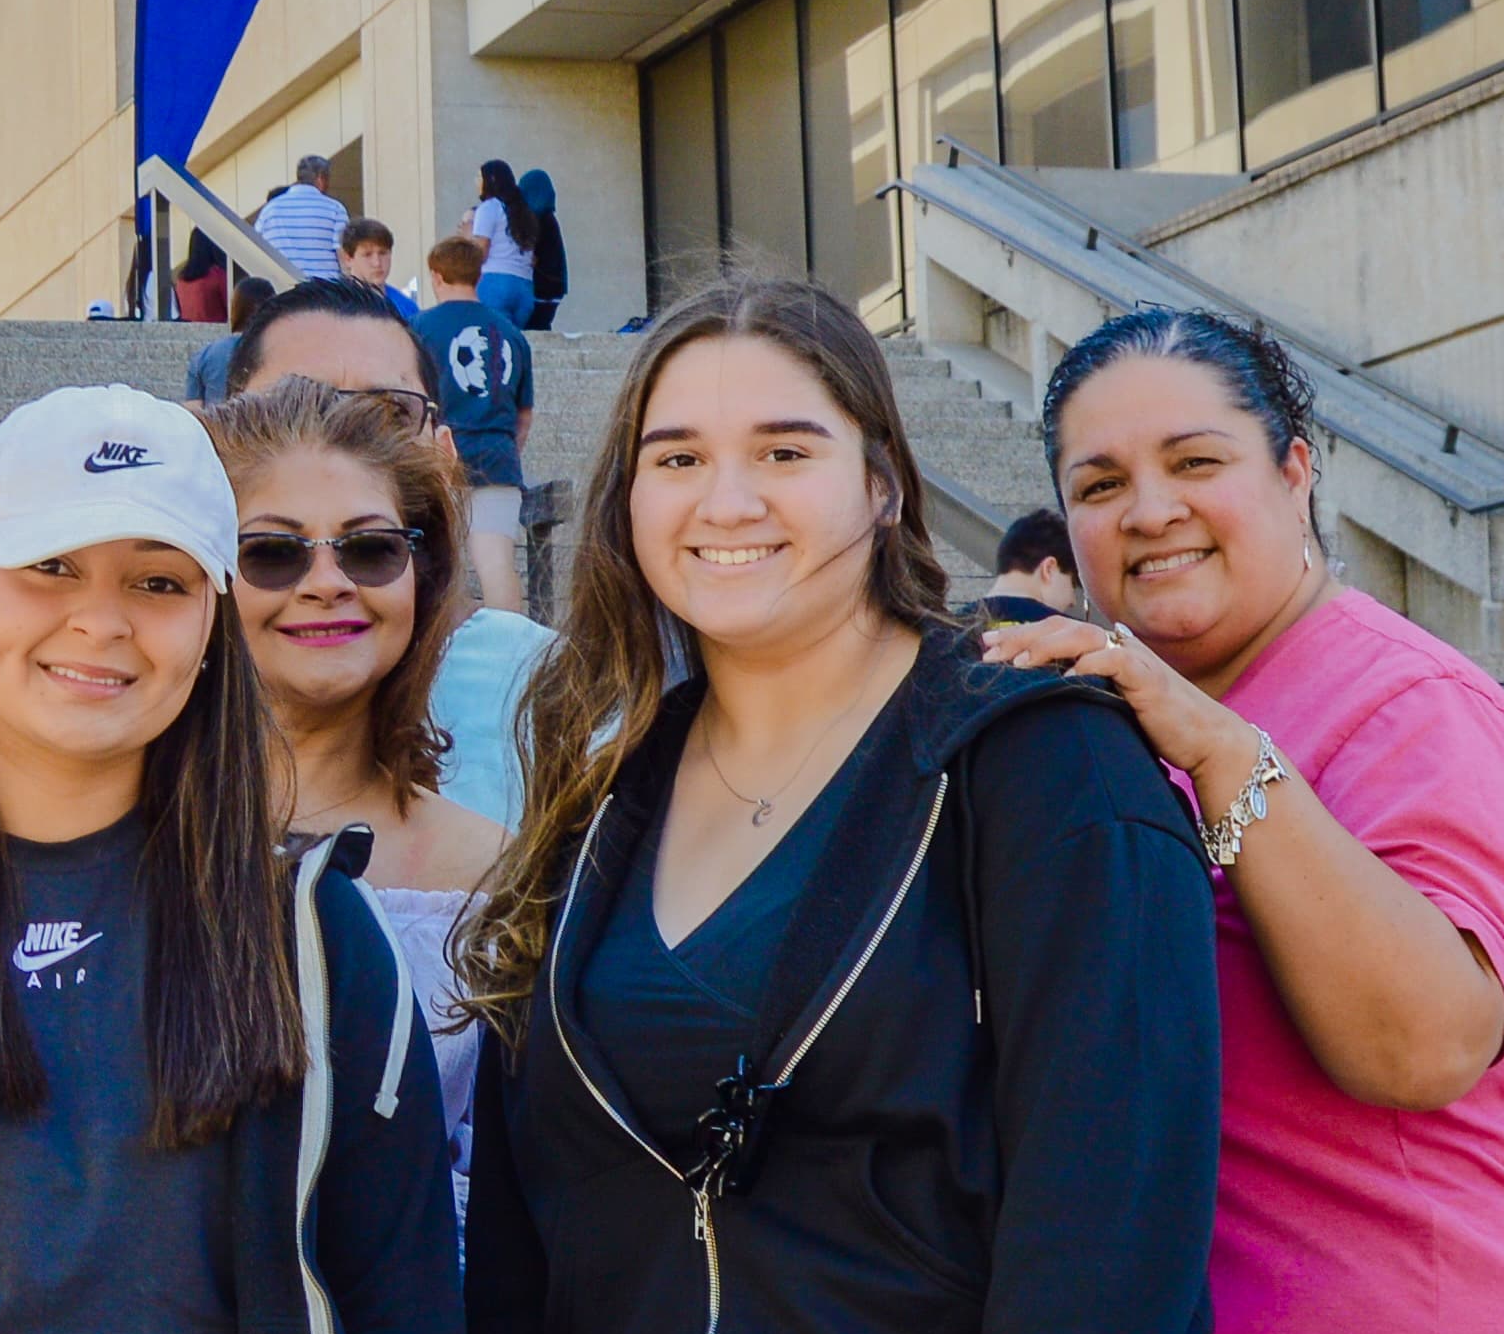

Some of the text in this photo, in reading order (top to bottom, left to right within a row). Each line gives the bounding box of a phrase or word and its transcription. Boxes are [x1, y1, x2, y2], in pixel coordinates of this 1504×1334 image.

[96, 441, 148, 463] NIKE
[23, 921, 83, 953] NIKE
[26, 968, 86, 990] AIR
